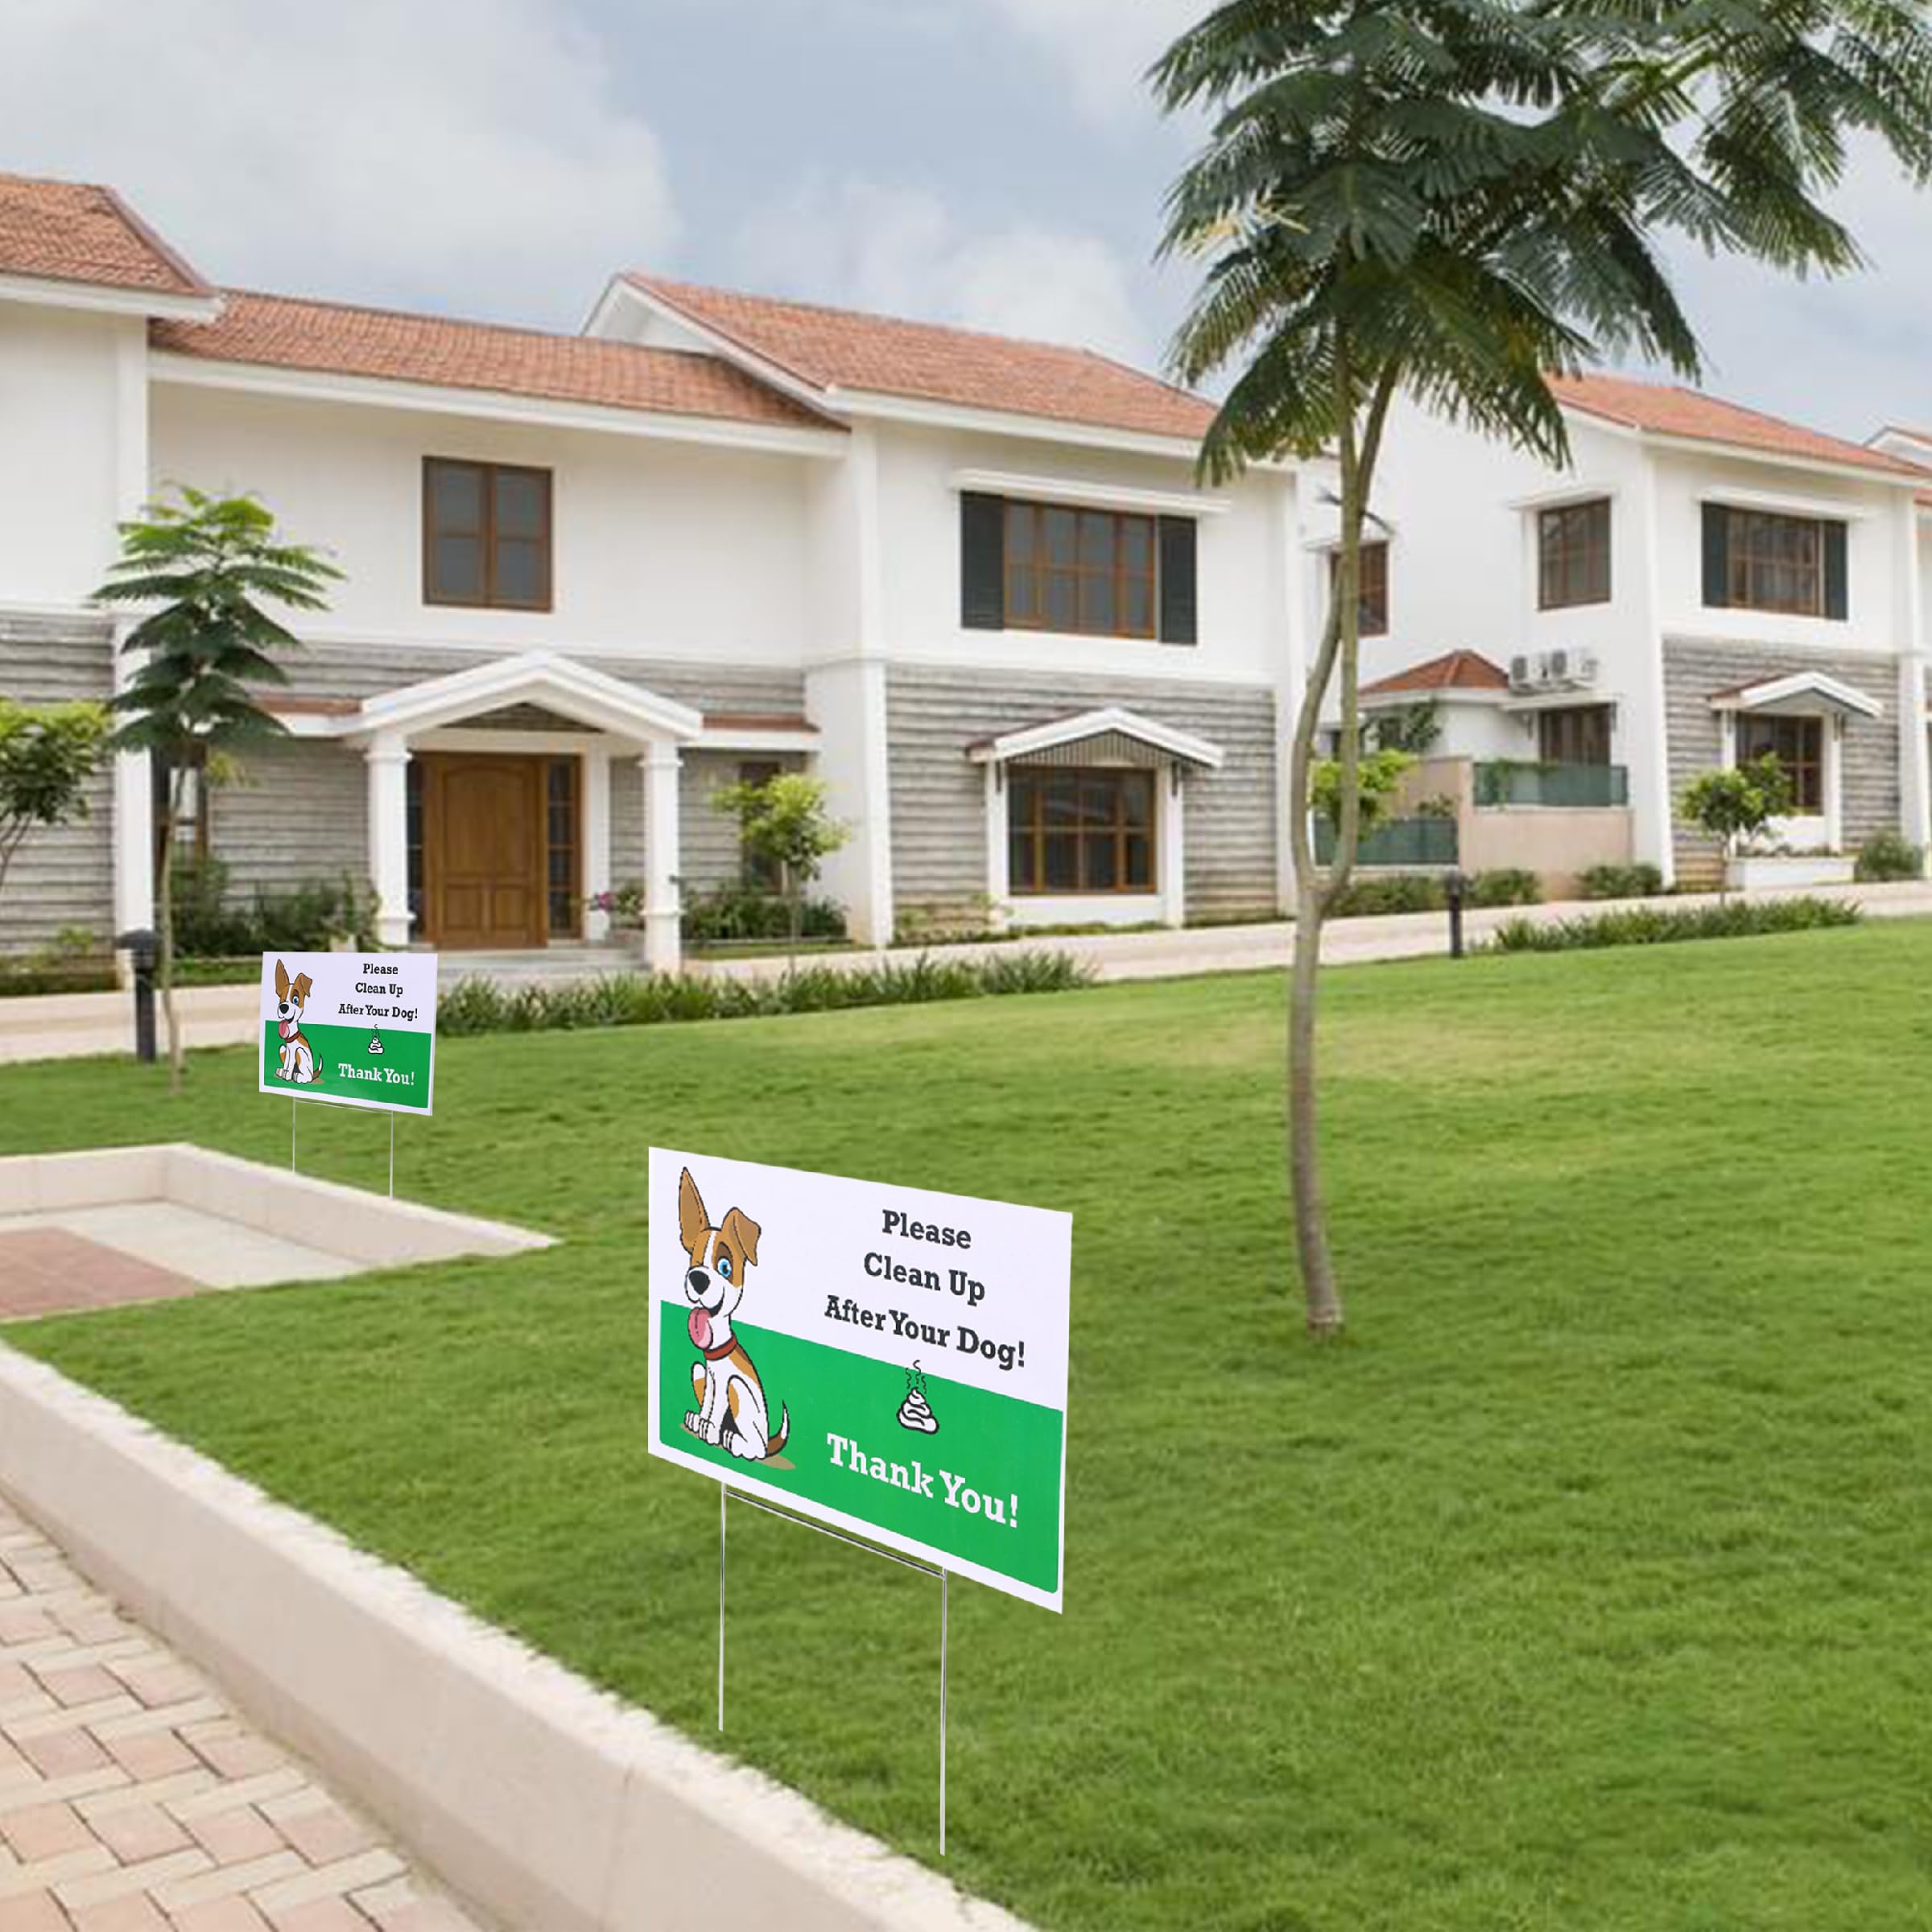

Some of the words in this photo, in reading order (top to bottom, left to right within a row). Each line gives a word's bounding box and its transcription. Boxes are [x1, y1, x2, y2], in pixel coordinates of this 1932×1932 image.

[363, 964, 398, 975] Please
[355, 983, 386, 994] Clean
[389, 984, 403, 997] Up
[338, 1004, 364, 1015] After
[365, 1005, 390, 1018] Your
[391, 1007, 418, 1021] Dog!
[338, 1063, 382, 1082] Thank
[383, 1068, 415, 1086] You!
[881, 1208, 972, 1249] Please
[863, 1253, 941, 1291] Clean
[948, 1269, 985, 1307] Up
[824, 1294, 886, 1331] After
[888, 1310, 951, 1347] Your
[956, 1325, 1025, 1371] Dog!
[827, 1433, 934, 1498] Thank
[938, 1470, 1018, 1528] You!
